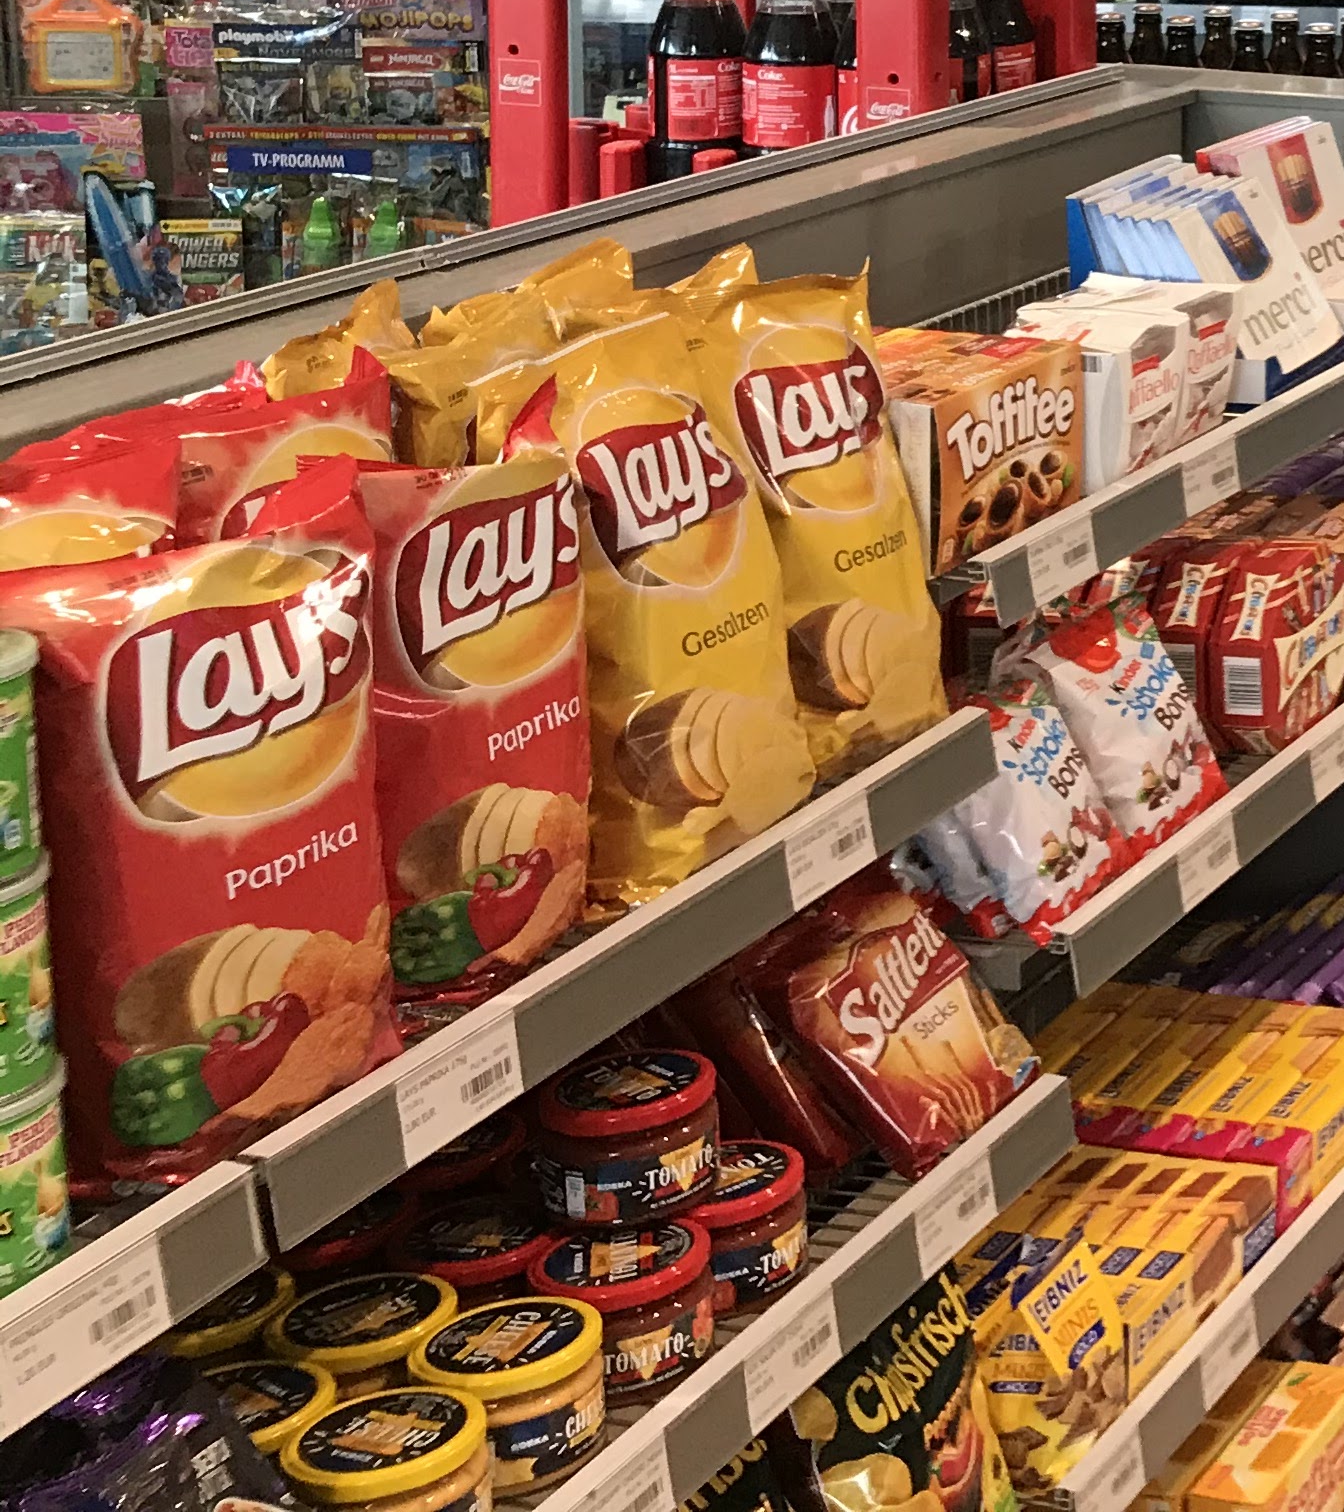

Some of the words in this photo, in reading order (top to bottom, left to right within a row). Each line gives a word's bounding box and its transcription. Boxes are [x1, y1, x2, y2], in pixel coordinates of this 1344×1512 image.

[252, 151, 345, 169] TV-PROGRAMM
[179, 248, 239, 268] ANGERS
[1244, 271, 1313, 348] merci
[749, 362, 868, 475] Lays
[946, 376, 1078, 483] Toffifee
[593, 418, 734, 551] Lay's
[417, 478, 582, 655] Lay's
[833, 528, 908, 575] Gesalzen
[680, 599, 771, 658] Gesalzen
[136, 566, 366, 783] Lay's
[486, 694, 581, 760] Paprika
[1047, 746, 1084, 801] Bons
[224, 819, 359, 900] Paprika
[837, 906, 946, 1068] Saltlett
[911, 996, 961, 1041] Sticks
[644, 1142, 714, 1192] TOMATO
[1028, 1257, 1090, 1334] LEIBNIZ
[1052, 1297, 1101, 1351] MINIS
[604, 1332, 685, 1376] TOMATO
[844, 1263, 972, 1436] Chipsfrisch
